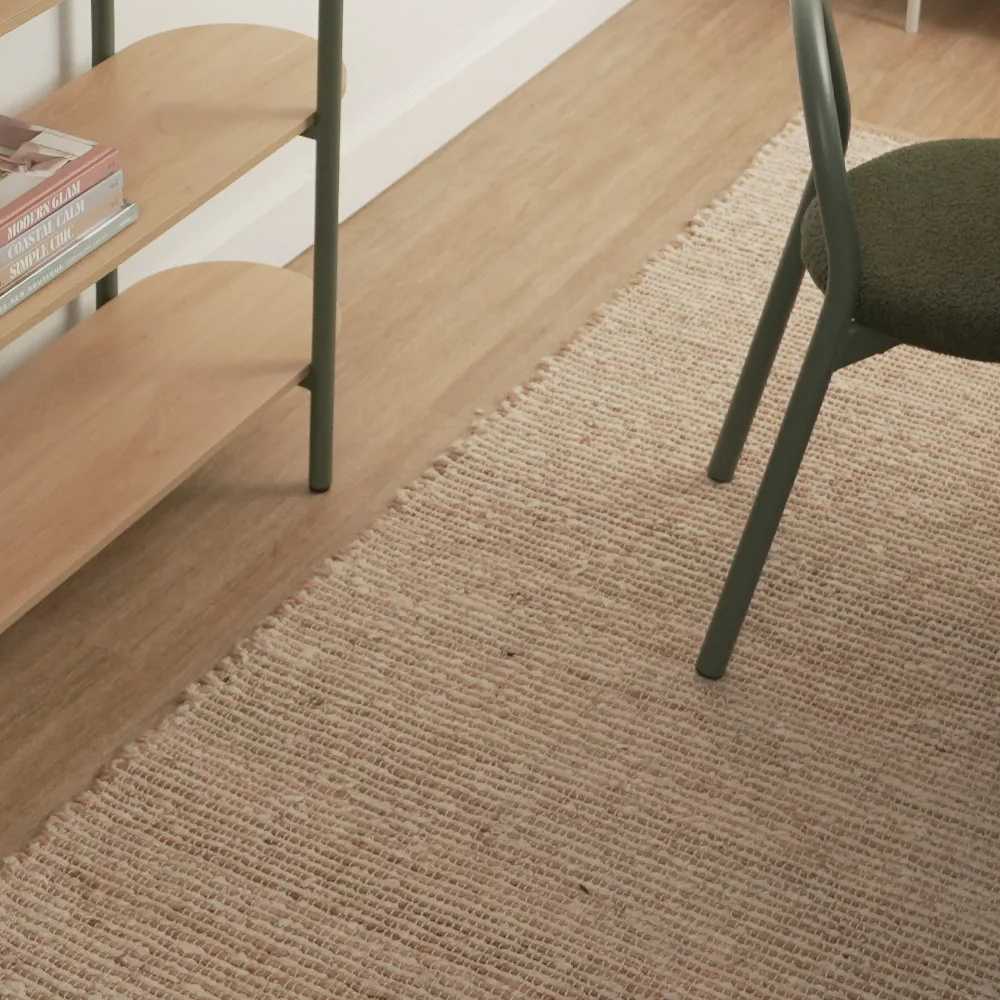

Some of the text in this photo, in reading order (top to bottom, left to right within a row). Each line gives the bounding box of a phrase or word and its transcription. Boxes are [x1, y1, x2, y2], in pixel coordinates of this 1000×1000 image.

[7, 179, 81, 241] MODERN GLAM
[7, 219, 55, 260] COASTAL
[56, 199, 85, 228] CALM
[9, 242, 49, 280] SIMPLE
[49, 224, 74, 251] CHIC
